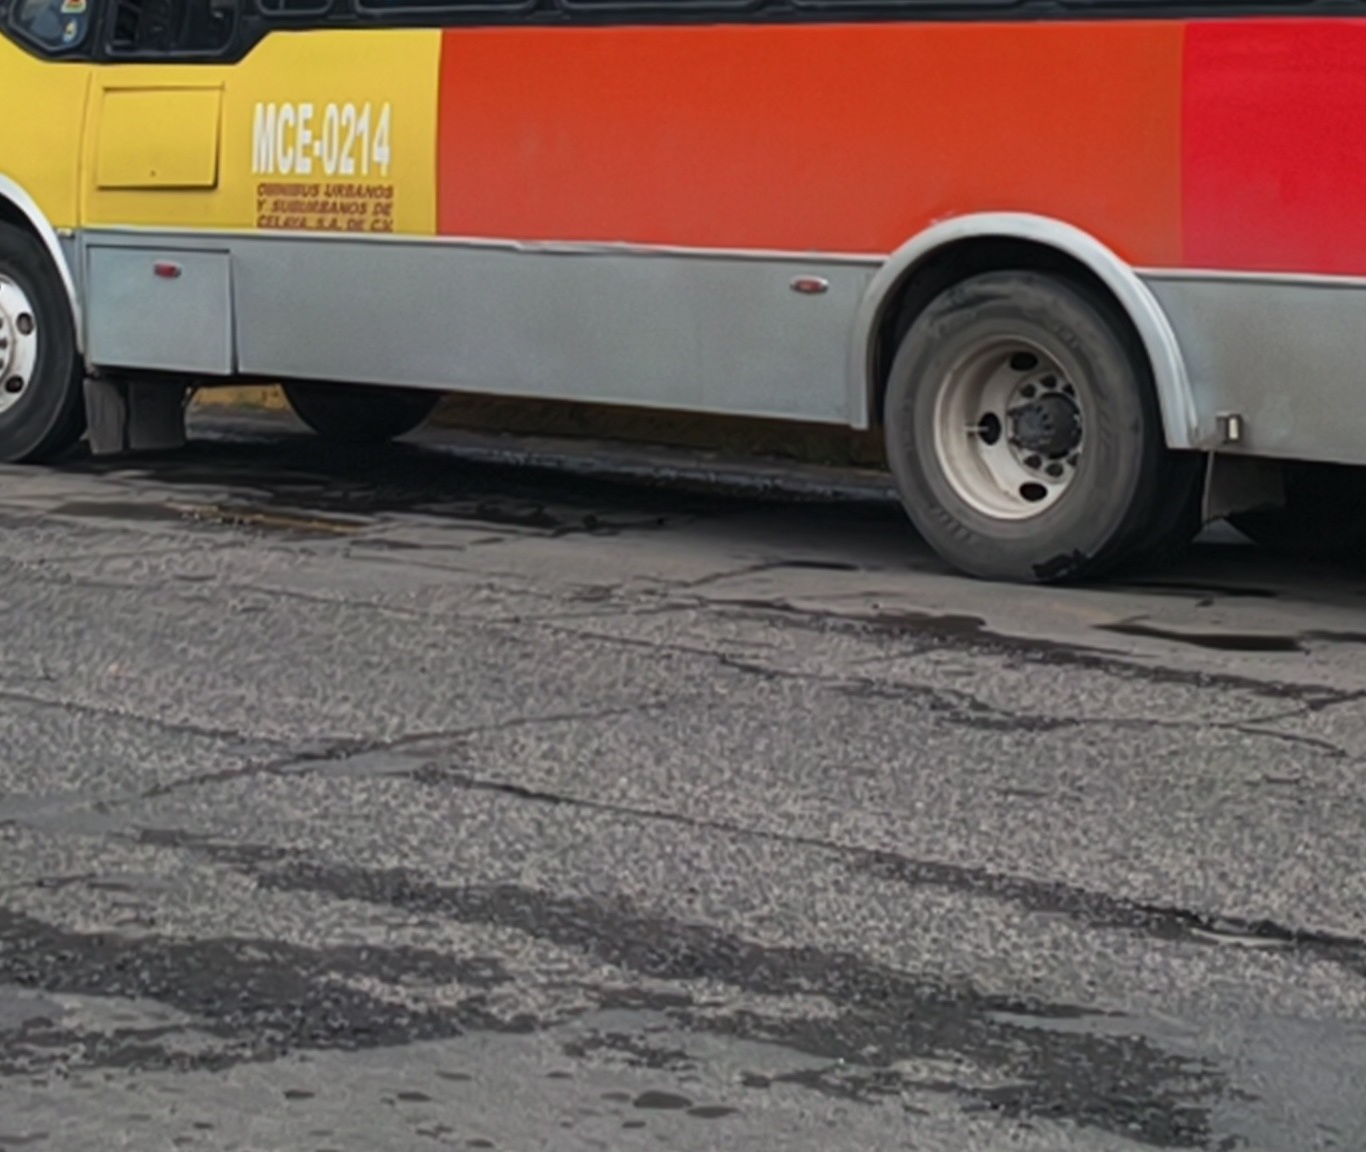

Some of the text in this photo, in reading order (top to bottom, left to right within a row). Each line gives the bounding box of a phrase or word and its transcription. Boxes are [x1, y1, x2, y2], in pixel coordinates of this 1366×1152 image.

[251, 101, 392, 177] MCE-0214
[324, 183, 393, 199] URBANOS
[257, 198, 393, 217] Y SUBURBANOS DE
[347, 218, 365, 233] DE
